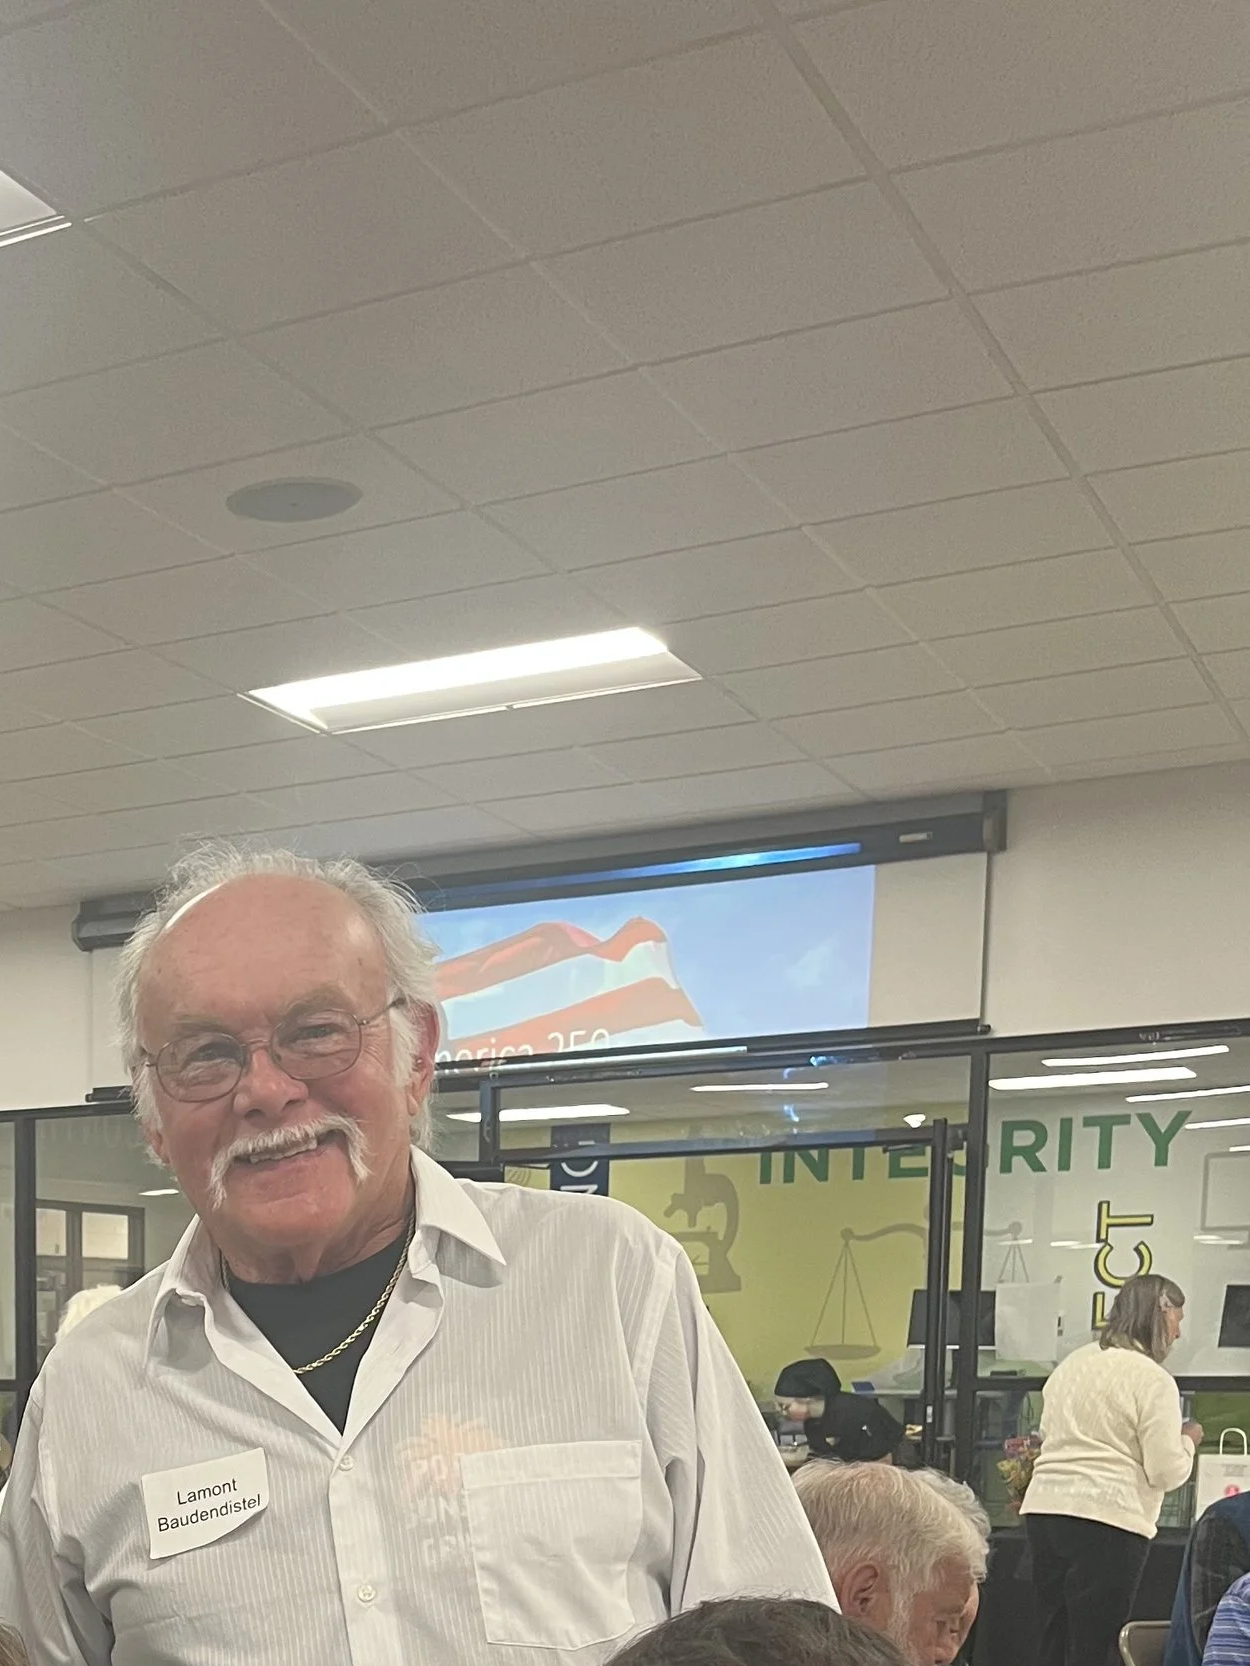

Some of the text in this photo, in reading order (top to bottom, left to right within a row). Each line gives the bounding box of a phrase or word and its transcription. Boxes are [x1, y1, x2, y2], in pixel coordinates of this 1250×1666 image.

[758, 1110, 1193, 1185] INTERITY
[177, 1478, 237, 1505] Lamont
[157, 1494, 261, 1532] Baudendistel
